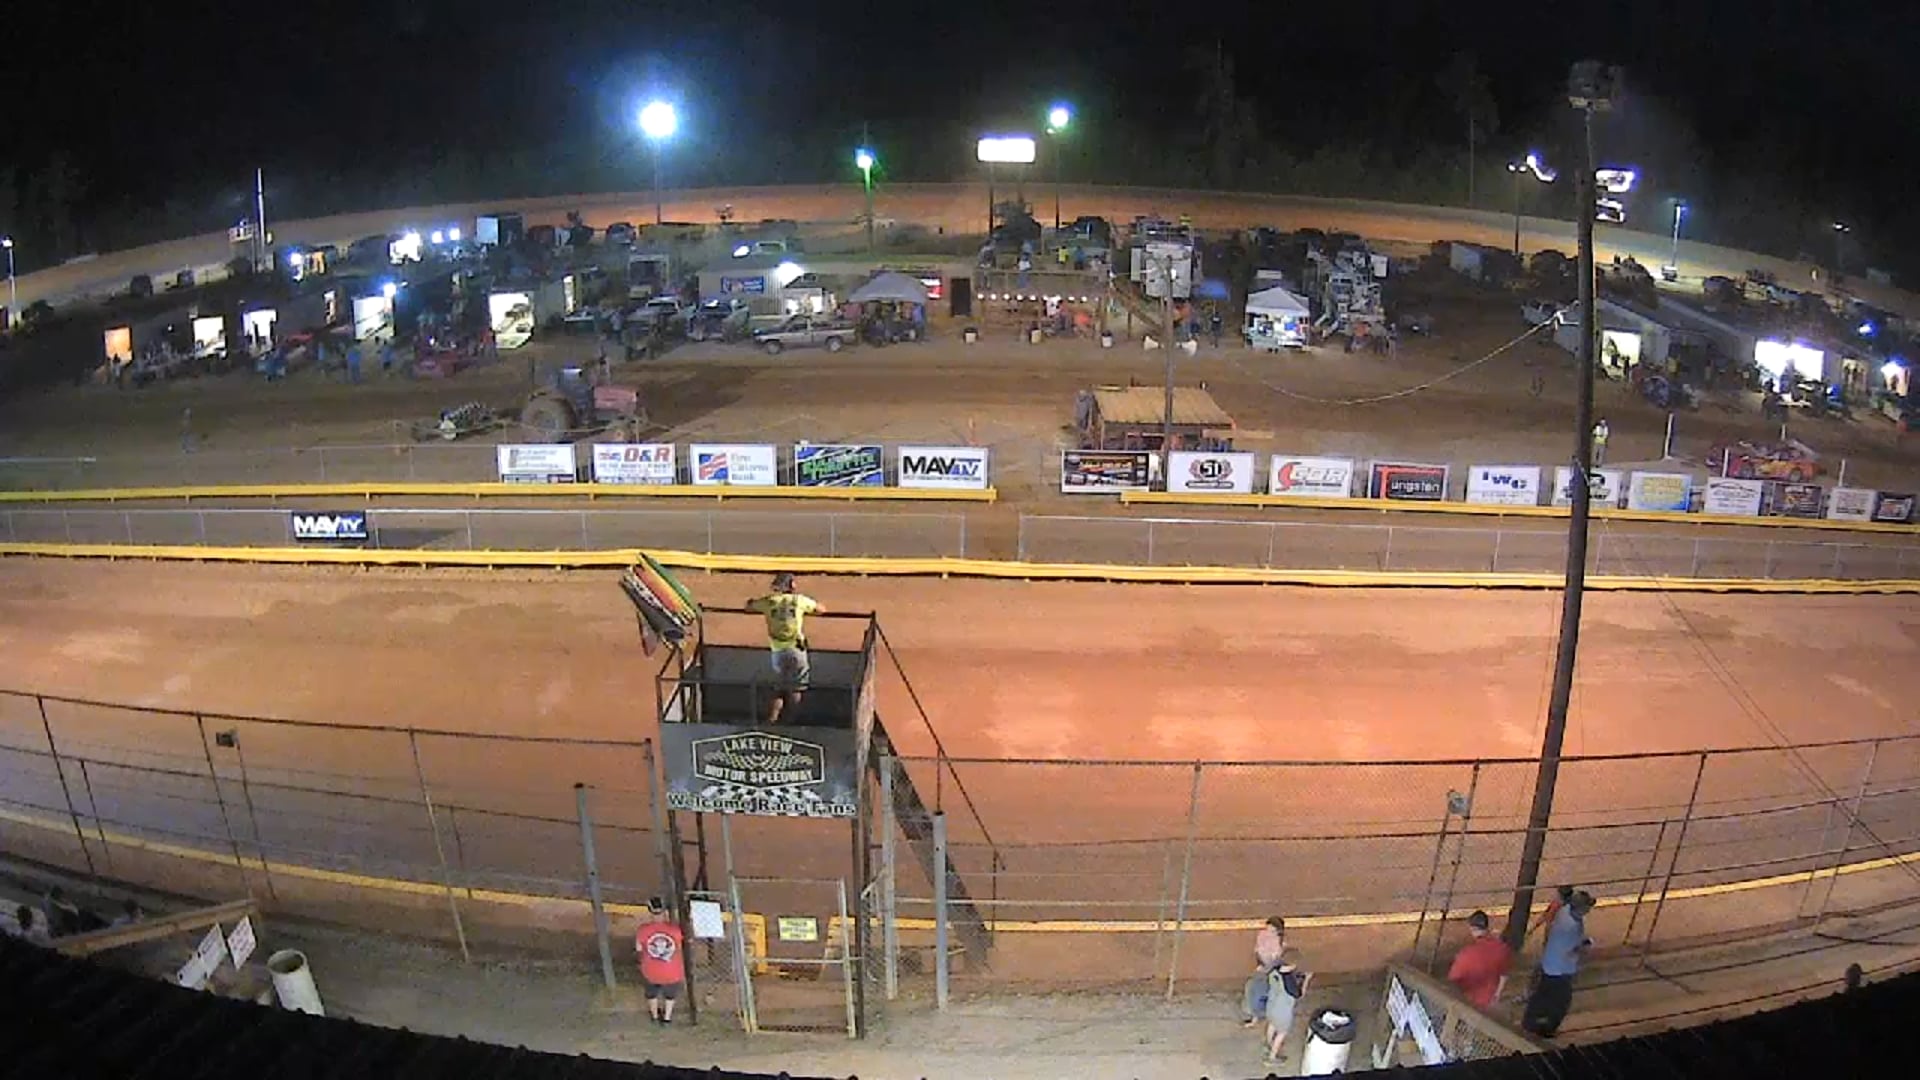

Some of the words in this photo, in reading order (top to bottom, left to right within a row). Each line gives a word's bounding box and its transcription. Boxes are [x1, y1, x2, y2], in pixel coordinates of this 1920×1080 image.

[723, 738, 756, 752] LAKE
[760, 738, 793, 753] VIEW
[704, 764, 747, 781] MOTOR
[750, 768, 813, 783] SPEEDWAY
[668, 792, 752, 811] Welcome
[758, 798, 806, 813] Race
[808, 800, 857, 816] Fans
